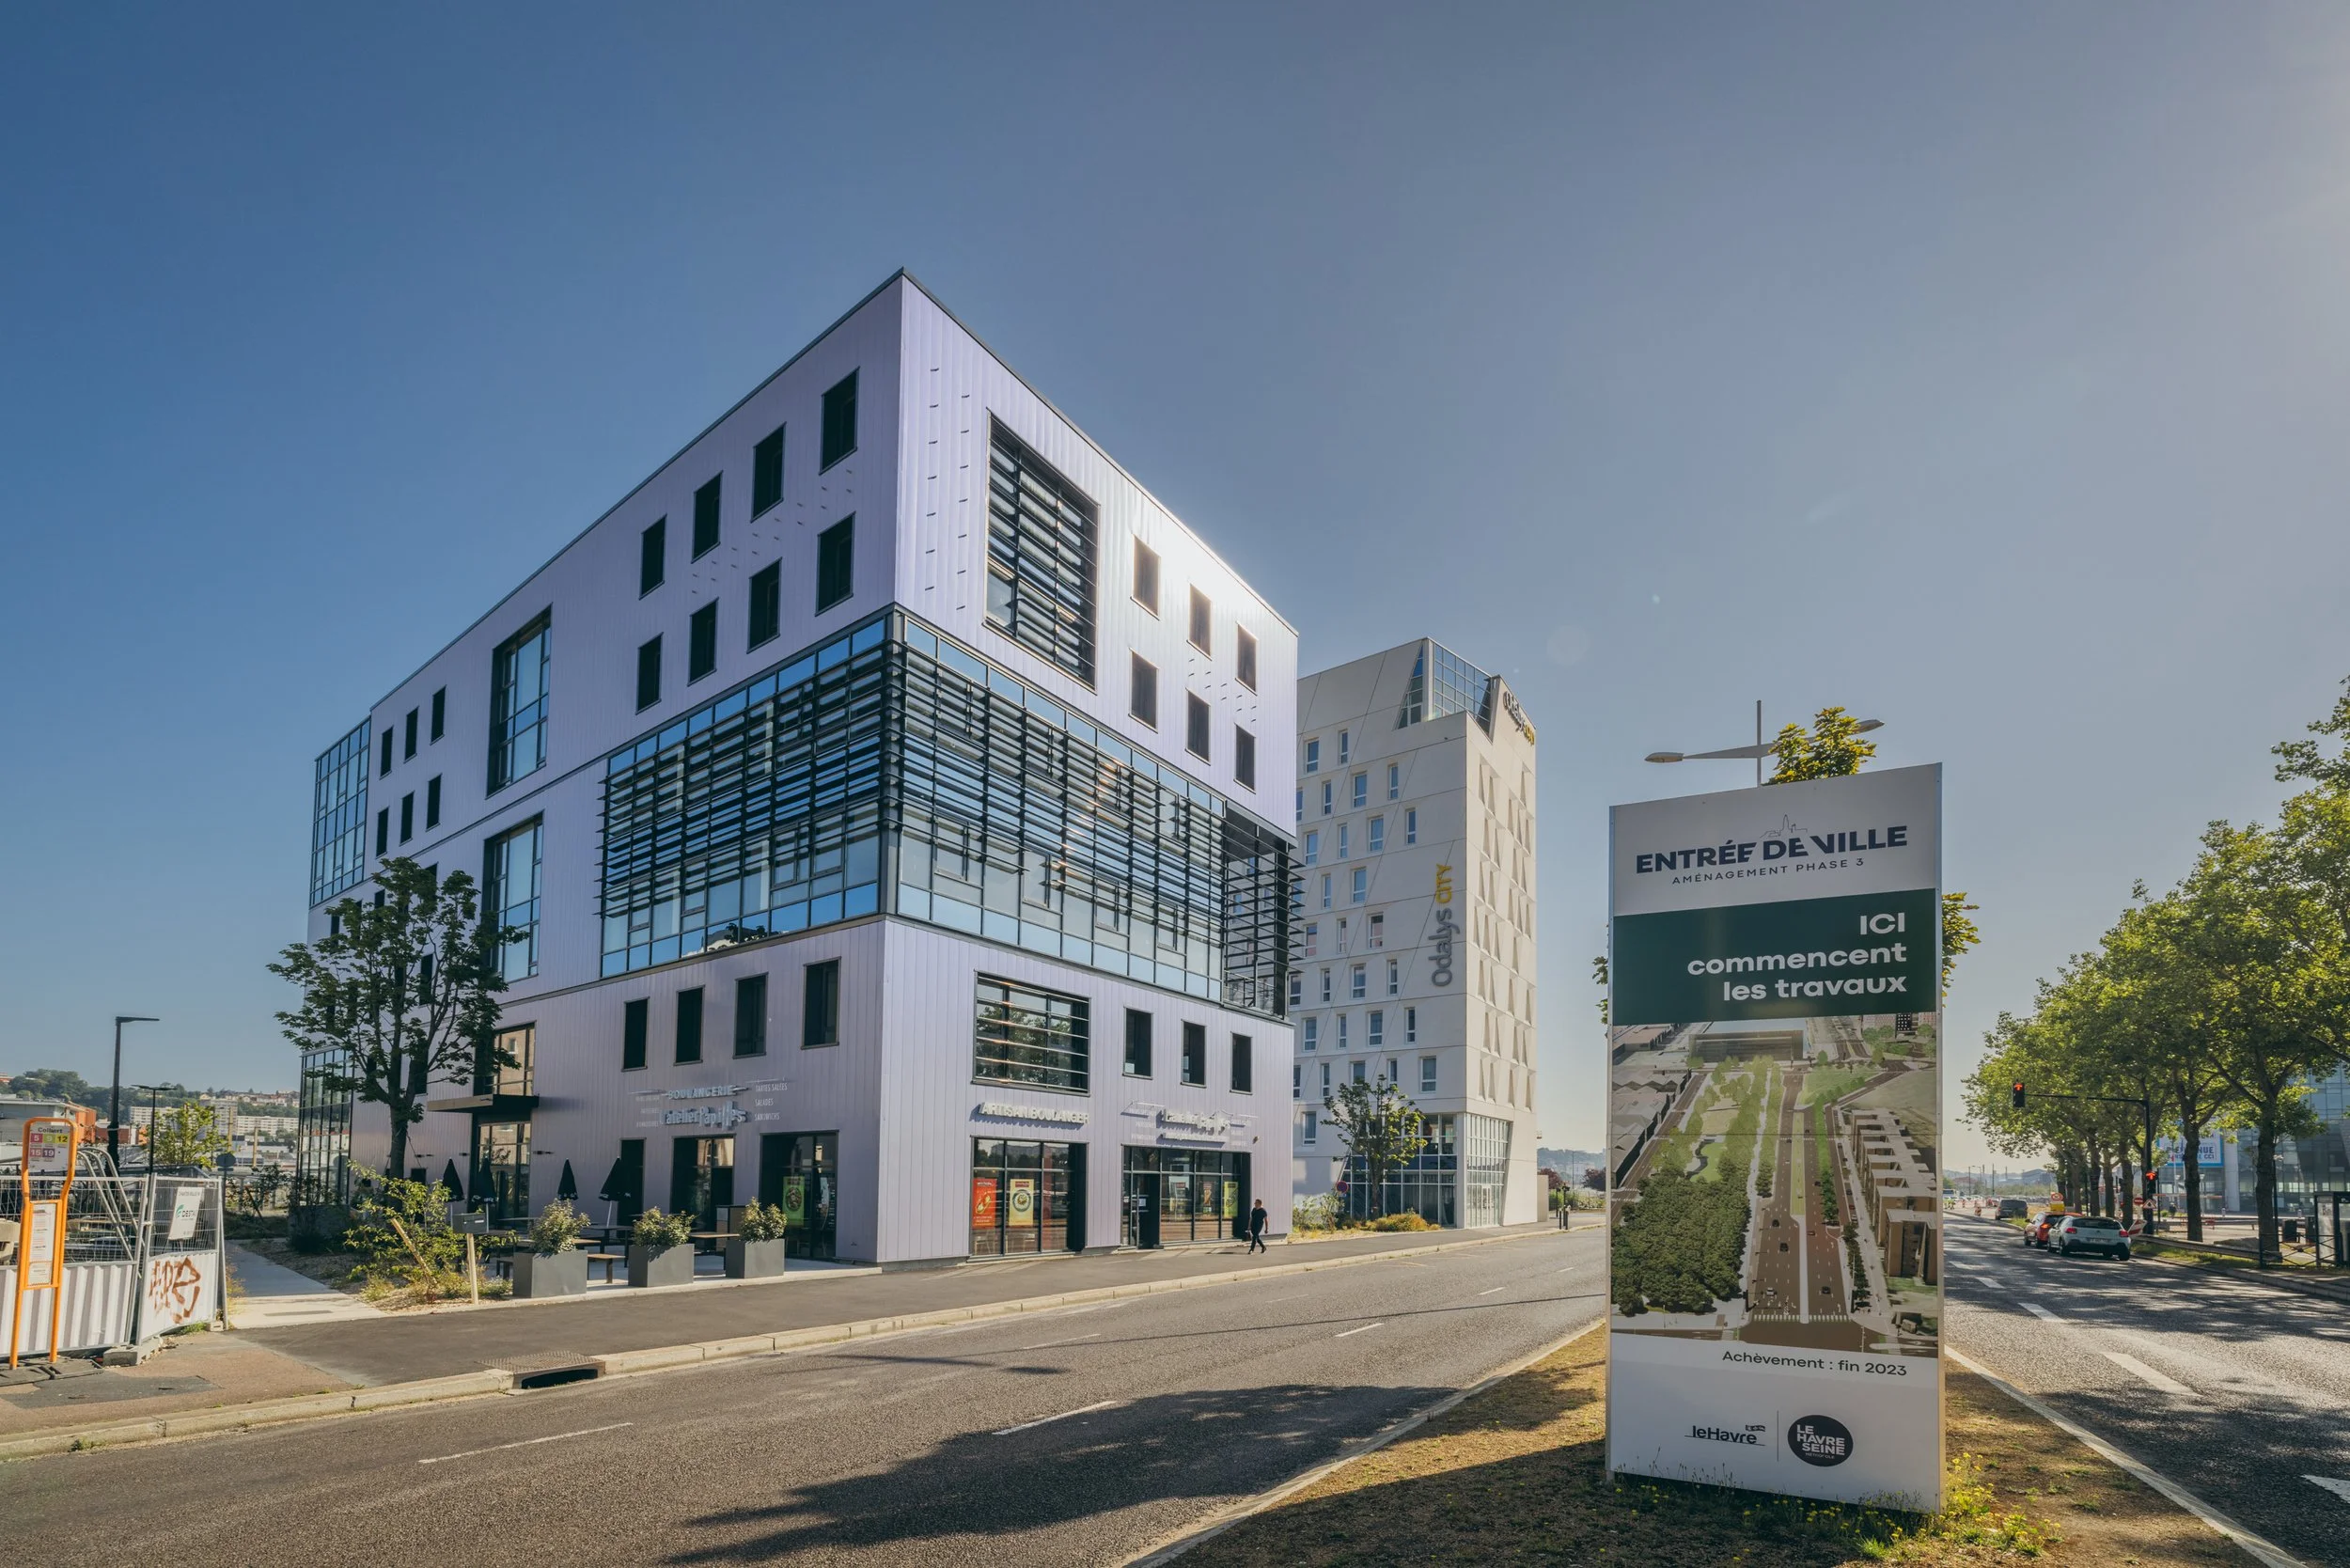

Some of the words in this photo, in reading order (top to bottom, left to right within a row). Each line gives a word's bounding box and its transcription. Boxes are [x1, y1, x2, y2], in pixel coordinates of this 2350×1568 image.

[1637, 839, 1757, 873] ENTRÉE
[1763, 837, 1809, 860] DE
[1810, 825, 1907, 854] VILLE
[1672, 866, 1788, 885] AMÉNAGEMENT
[1796, 859, 1848, 872] PHASE
[1856, 857, 1864, 866] 3
[1860, 912, 1905, 935] ICI
[1428, 907, 1461, 987] Odalys
[1687, 943, 1907, 976] commencent
[1724, 981, 1767, 1001] les
[1775, 976, 1907, 998] travaux
[668, 1086, 736, 1100] BOULANGERIE
[979, 1102, 1028, 1119] ARTISAN
[1029, 1107, 1089, 1124] BOULANGER
[1722, 1351, 1825, 1370] Achèvement
[1838, 1359, 1859, 1372] fin
[1865, 1362, 1907, 1376] 2023
[1796, 1424, 1814, 1435] LE
[1796, 1434, 1845, 1447] HAVRE
[1802, 1443, 1845, 1456] SEINE
